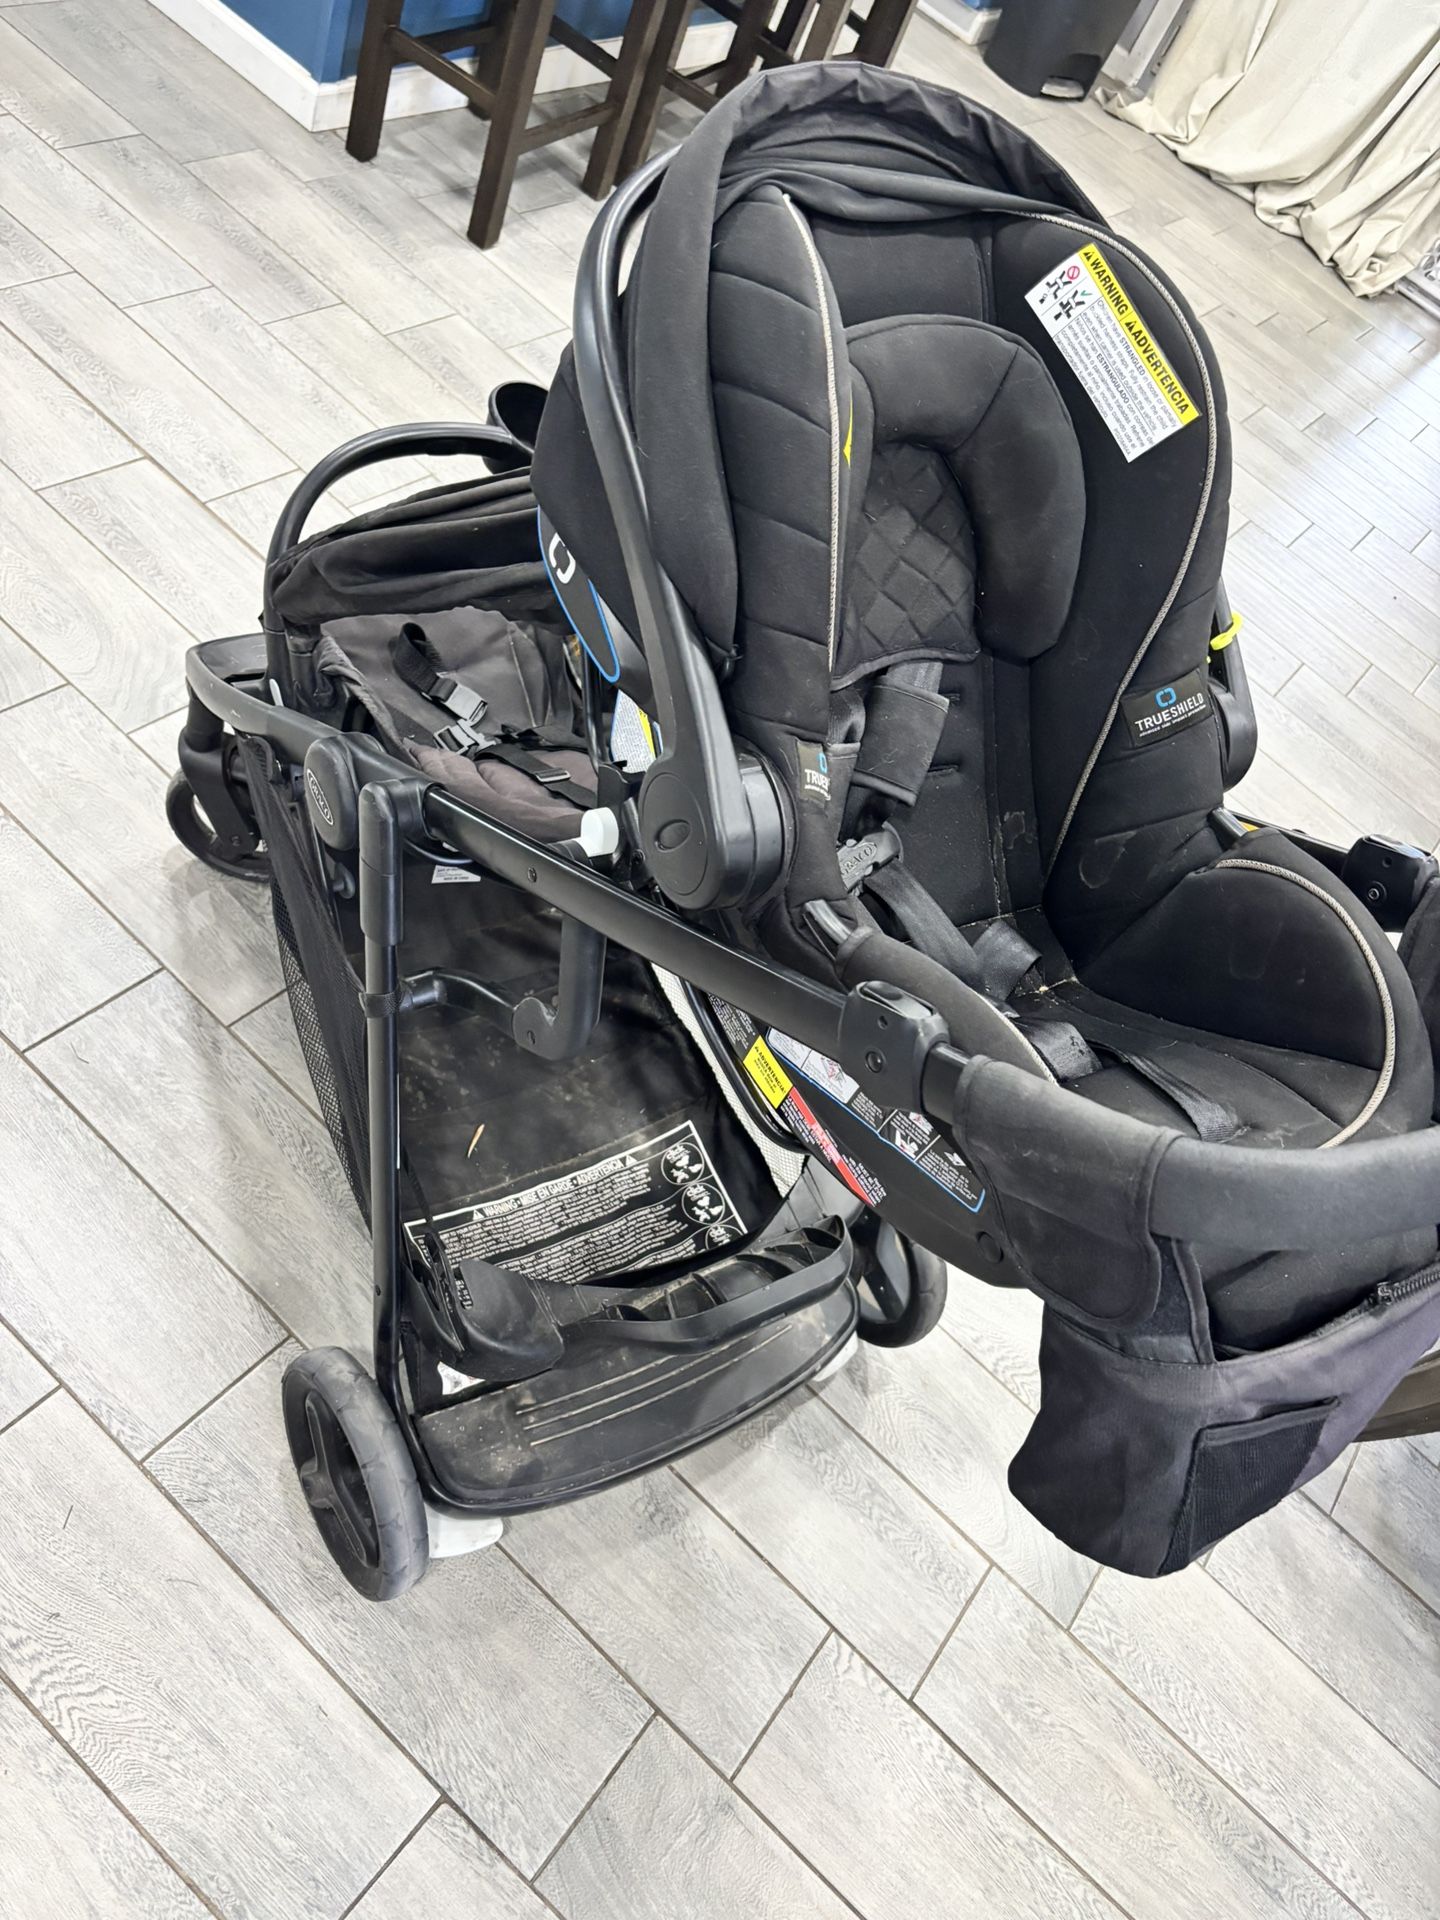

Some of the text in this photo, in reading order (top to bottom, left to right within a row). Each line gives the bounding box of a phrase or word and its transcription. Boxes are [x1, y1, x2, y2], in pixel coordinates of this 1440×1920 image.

[1088, 257, 1190, 415] WARNING ADVERTENCIA
[1118, 336, 1146, 376] STRANGLED
[1095, 352, 1130, 404] ESTRANGULADO
[1134, 692, 1205, 731] TRUESHIELD
[482, 1158, 624, 1218] WARNING MISE EN GARDE ADVERTENCIA
